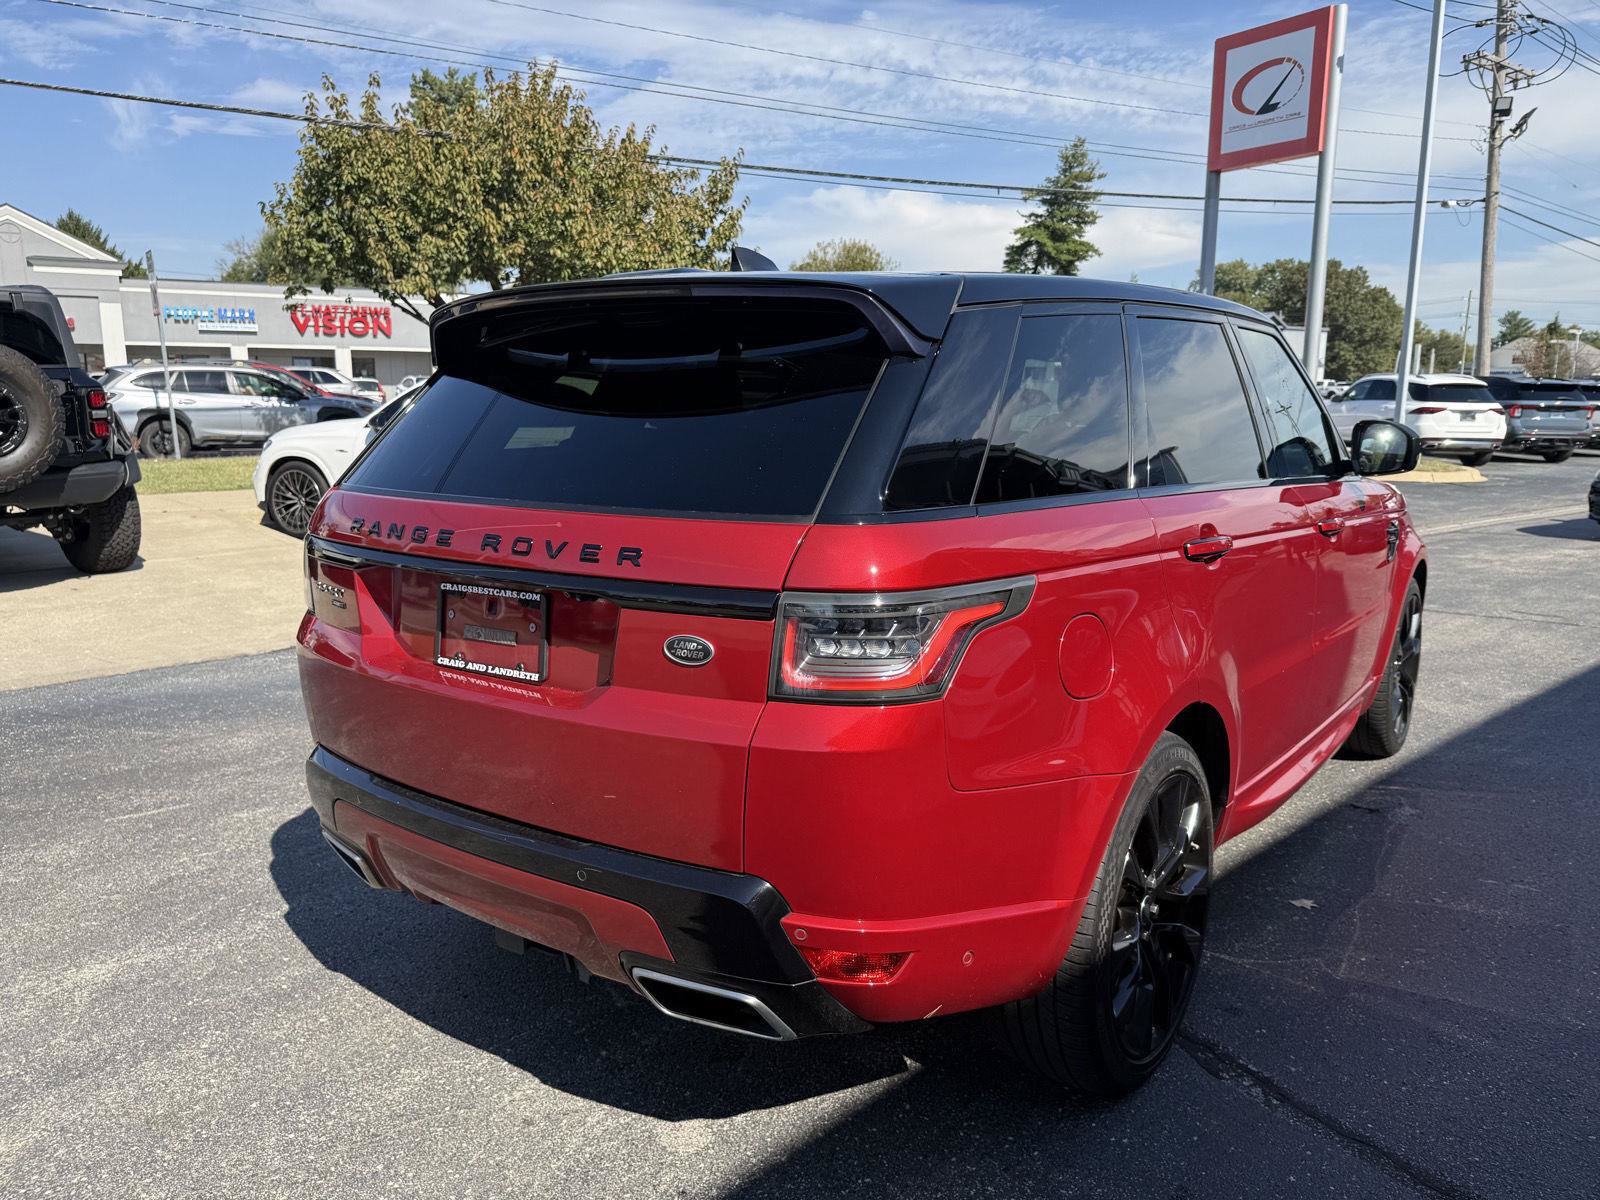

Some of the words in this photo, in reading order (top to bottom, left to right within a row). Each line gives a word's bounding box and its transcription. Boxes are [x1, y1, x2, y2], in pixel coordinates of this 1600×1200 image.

[312, 304, 391, 318] MATTHEWS
[291, 312, 392, 337] VISION
[350, 518, 454, 547] RANGE
[481, 533, 643, 567] ROVER
[440, 582, 541, 601] CRAIGSBESTCARS.COM
[674, 640, 697, 650] LAND
[675, 649, 705, 659] ROVER
[437, 656, 465, 668] CRAIG
[466, 661, 487, 672] AND
[487, 665, 539, 681] LANDRETH
